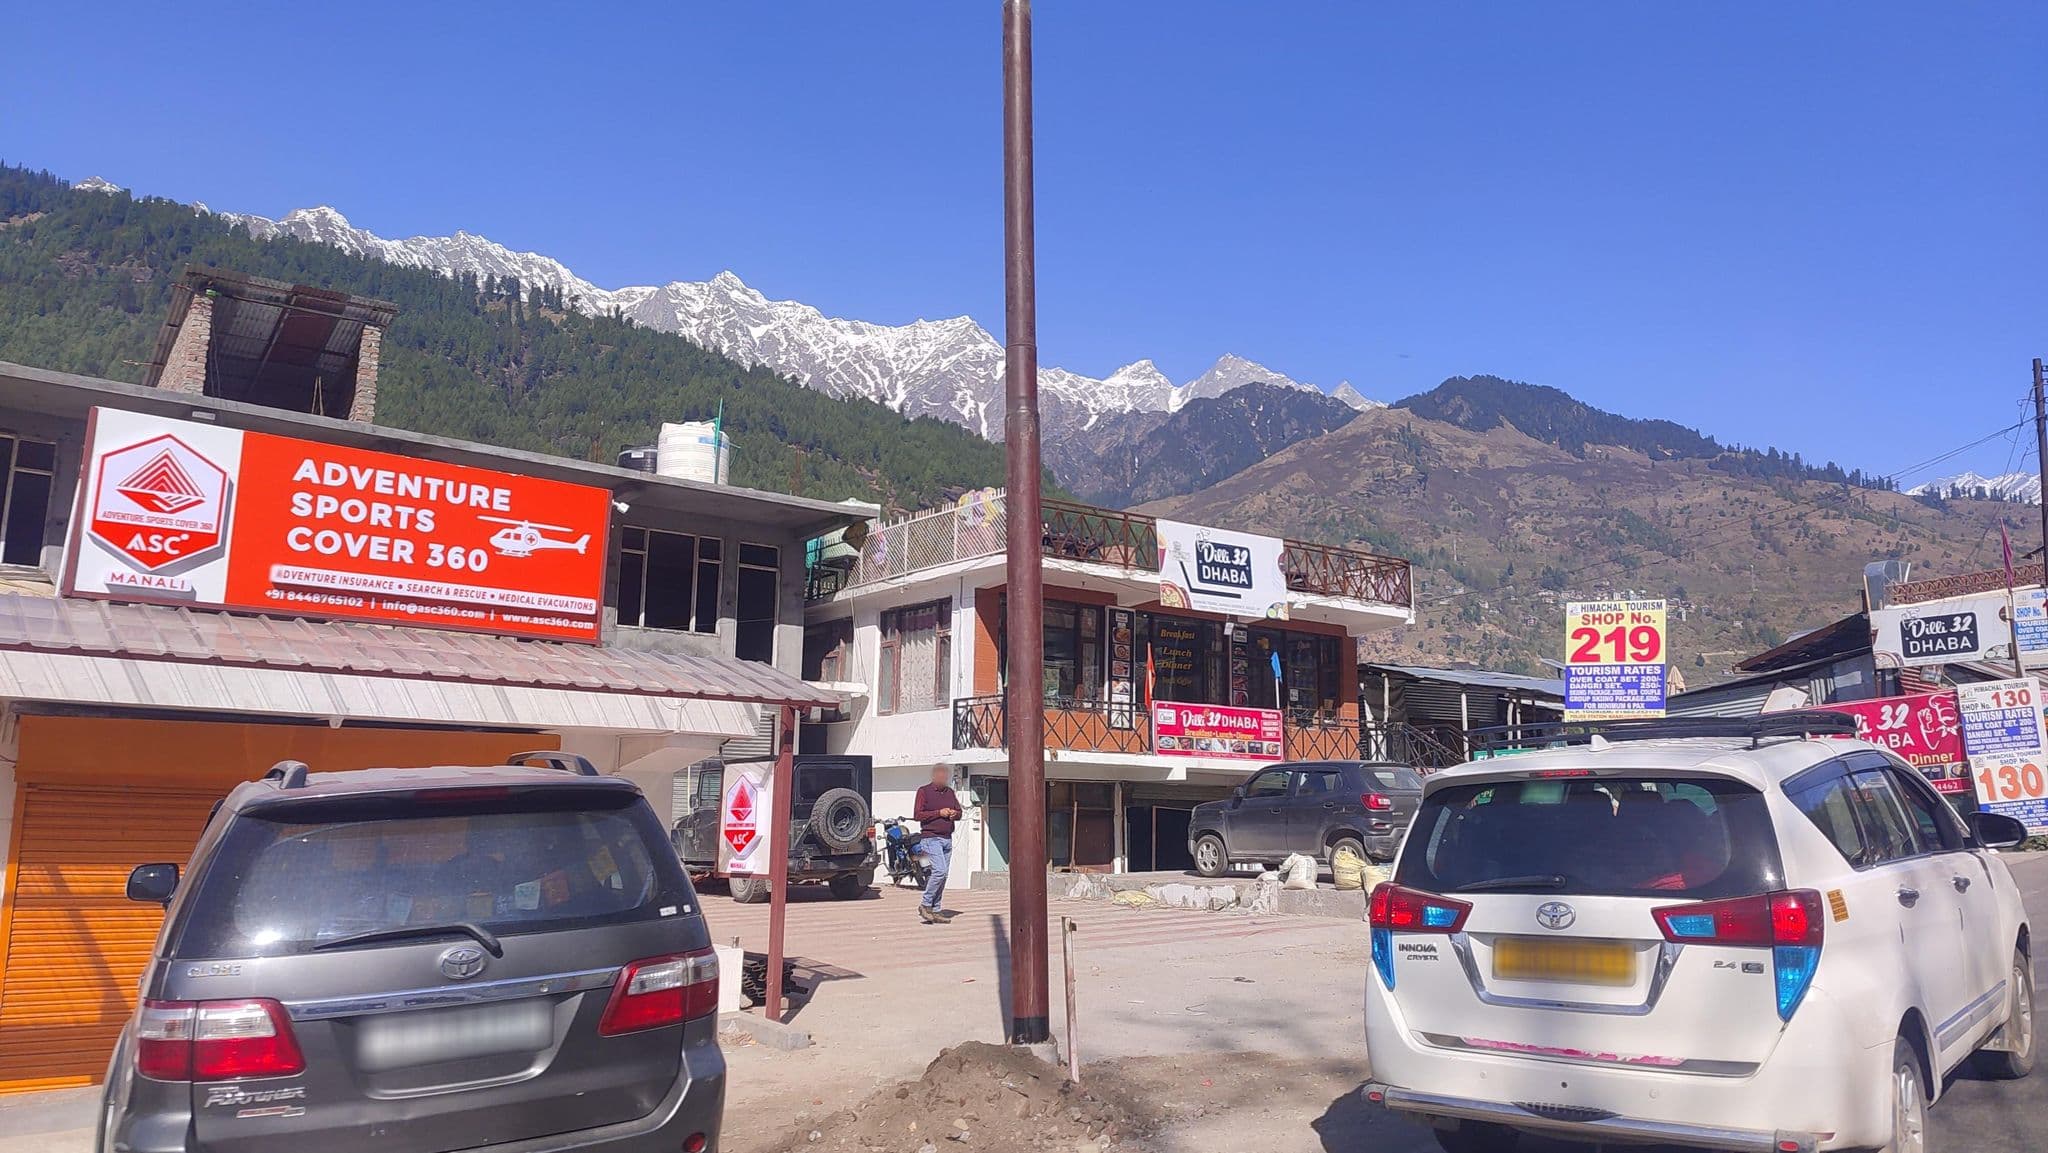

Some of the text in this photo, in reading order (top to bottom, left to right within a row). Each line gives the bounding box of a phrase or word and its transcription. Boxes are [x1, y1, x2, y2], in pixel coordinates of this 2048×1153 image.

[292, 458, 512, 512] ADVENTURE
[102, 511, 213, 531] ADVENTURE SPORTS COVER 360
[290, 491, 435, 533] SPORTS
[126, 532, 182, 555] ASC
[286, 526, 489, 572] COVER 360
[1202, 542, 1249, 566] Dilli 32
[110, 572, 185, 590] MANALI
[1202, 565, 1248, 585] DHABA
[276, 569, 336, 584] DVENTURE
[338, 577, 394, 591] INSURANCE
[406, 583, 442, 595] SEARCH
[453, 588, 487, 600] RESCUE
[498, 593, 535, 605] MEDICAL
[537, 596, 594, 611] EVACUATIONS
[265, 588, 594, 630] +91 8448765102 info@asc360.com www.asc360.com
[1581, 601, 1663, 613] HIMACHAL TOURISM
[1581, 612, 1656, 625] SHOP No.
[1910, 615, 1973, 638] Dilli 32
[1160, 629, 1195, 641] Breakfast
[1570, 626, 1660, 662] 219
[1162, 647, 1192, 657] Lunch
[1909, 636, 1972, 654] DHABA
[1161, 660, 1192, 670] Dinner
[1570, 665, 1661, 675] TOURISM RATES
[1974, 684, 2002, 693] HIMACHAL
[1961, 702, 1979, 711] SHOP
[1991, 688, 2031, 708] 130
[1180, 710, 1205, 727] Dilli
[1206, 711, 1221, 727] 32
[1222, 715, 1259, 730] DHABA
[1876, 703, 1909, 730] 32
[1963, 707, 2034, 724] TOURISM RATES
[1965, 723, 1984, 731] OVER
[1984, 721, 2002, 729] COAT
[1967, 730, 1992, 739] DANGRI
[1861, 732, 1915, 748] ABA
[1909, 752, 1954, 765] Dinner
[1979, 763, 2043, 801] 130
[733, 833, 748, 845] ASC
[1399, 943, 1438, 953] INNOVA
